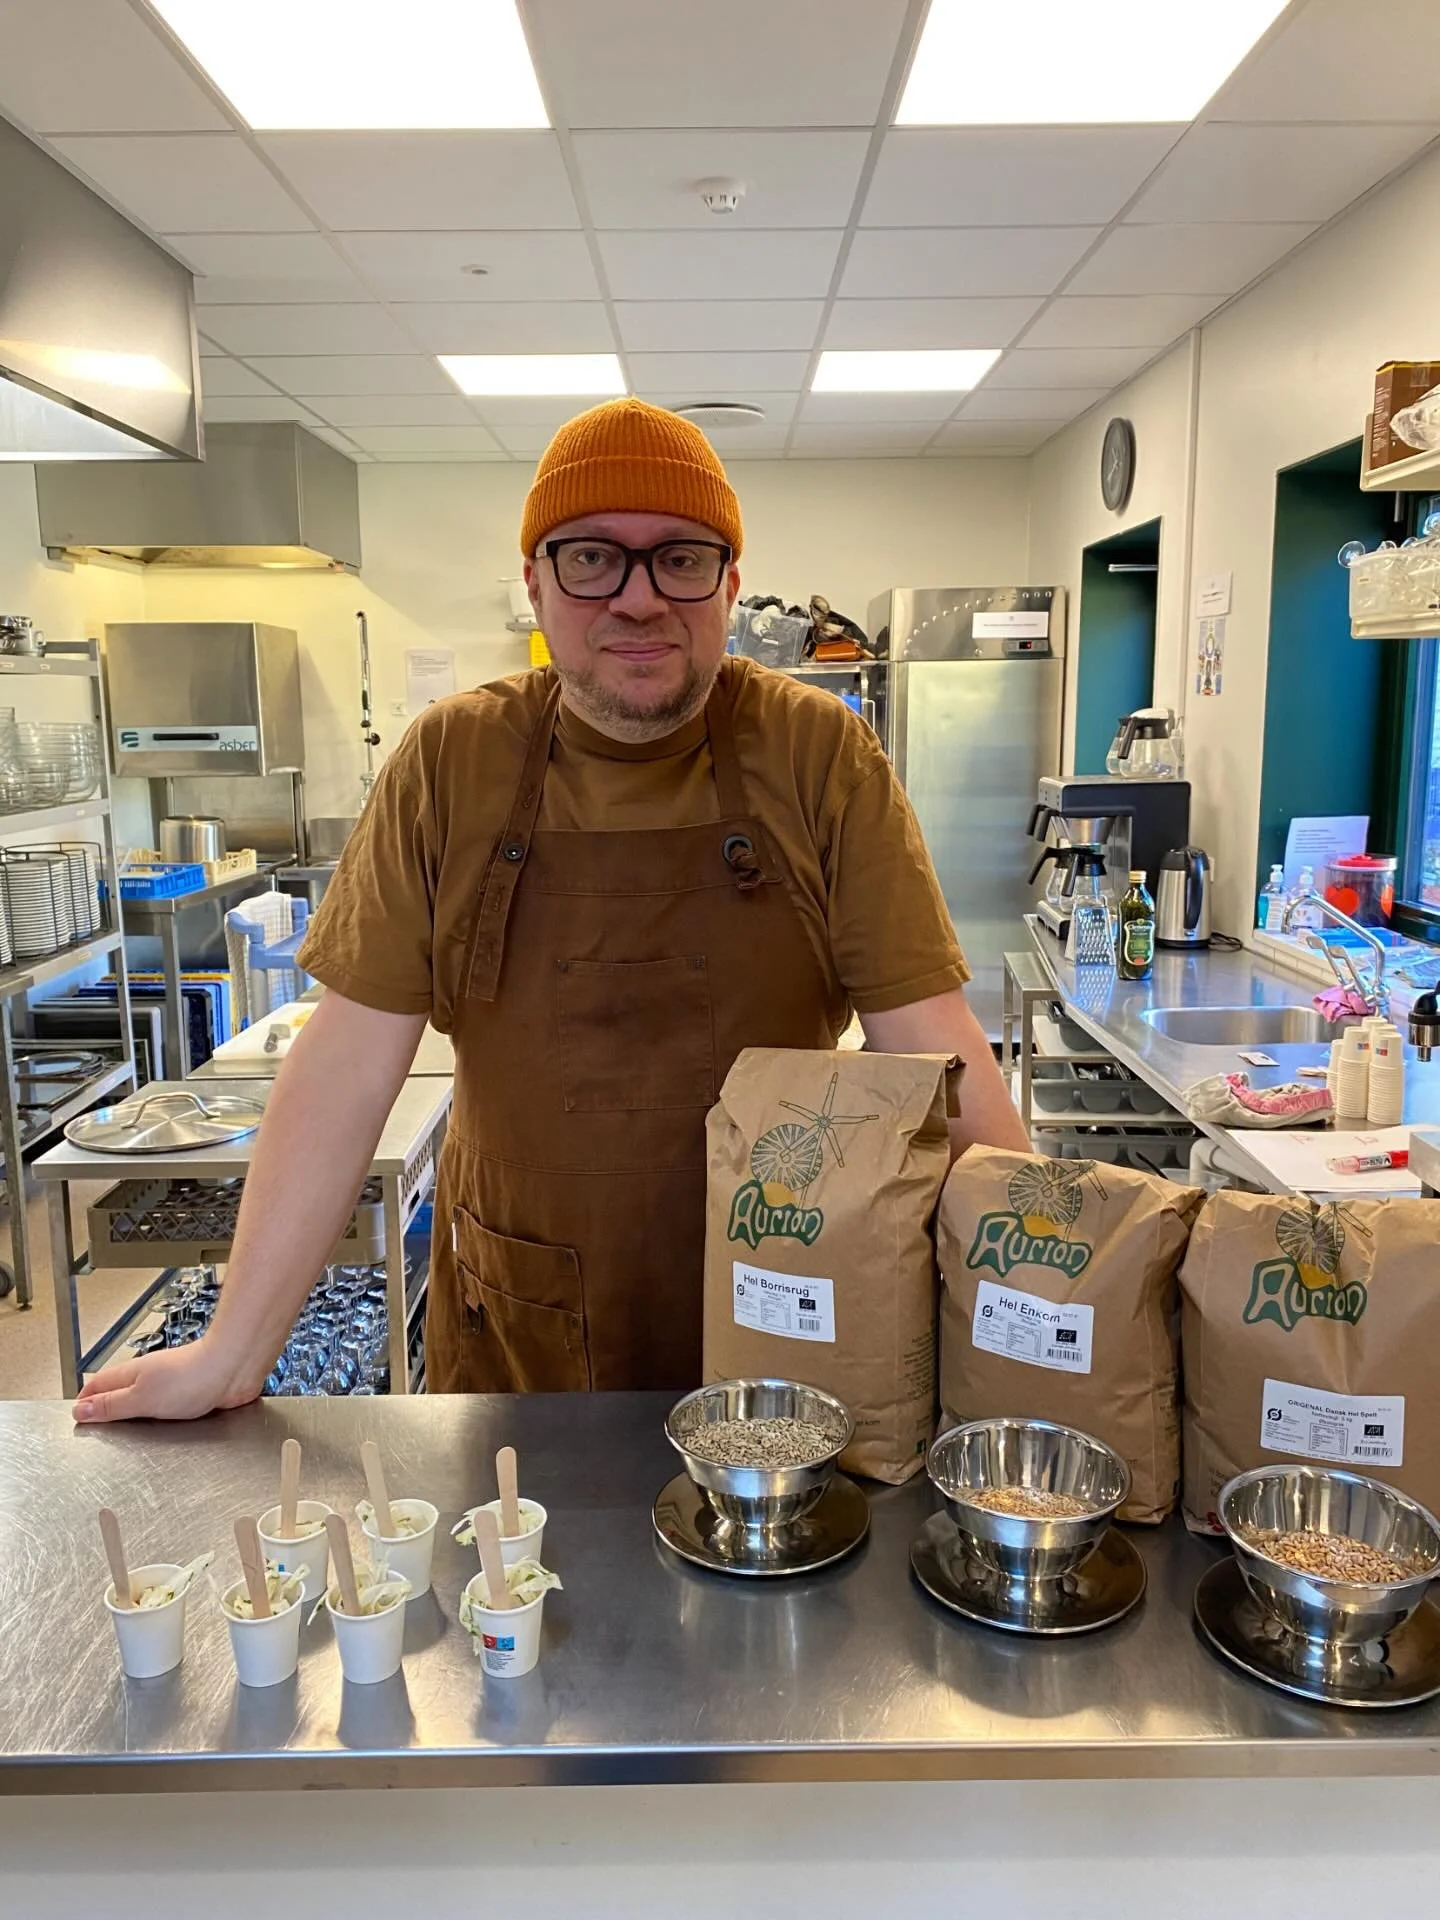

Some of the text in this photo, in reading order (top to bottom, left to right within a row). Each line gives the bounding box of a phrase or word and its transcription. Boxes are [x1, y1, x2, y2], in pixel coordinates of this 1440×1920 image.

[729, 1186, 821, 1246] Aurion
[970, 1216, 1089, 1273] Aurion
[743, 1273, 758, 1286] Hel
[760, 1278, 810, 1298] Borrisrug
[999, 1296, 1018, 1311] Hel
[1020, 1303, 1061, 1324] Enkorn
[1247, 1262, 1364, 1328] Aurion
